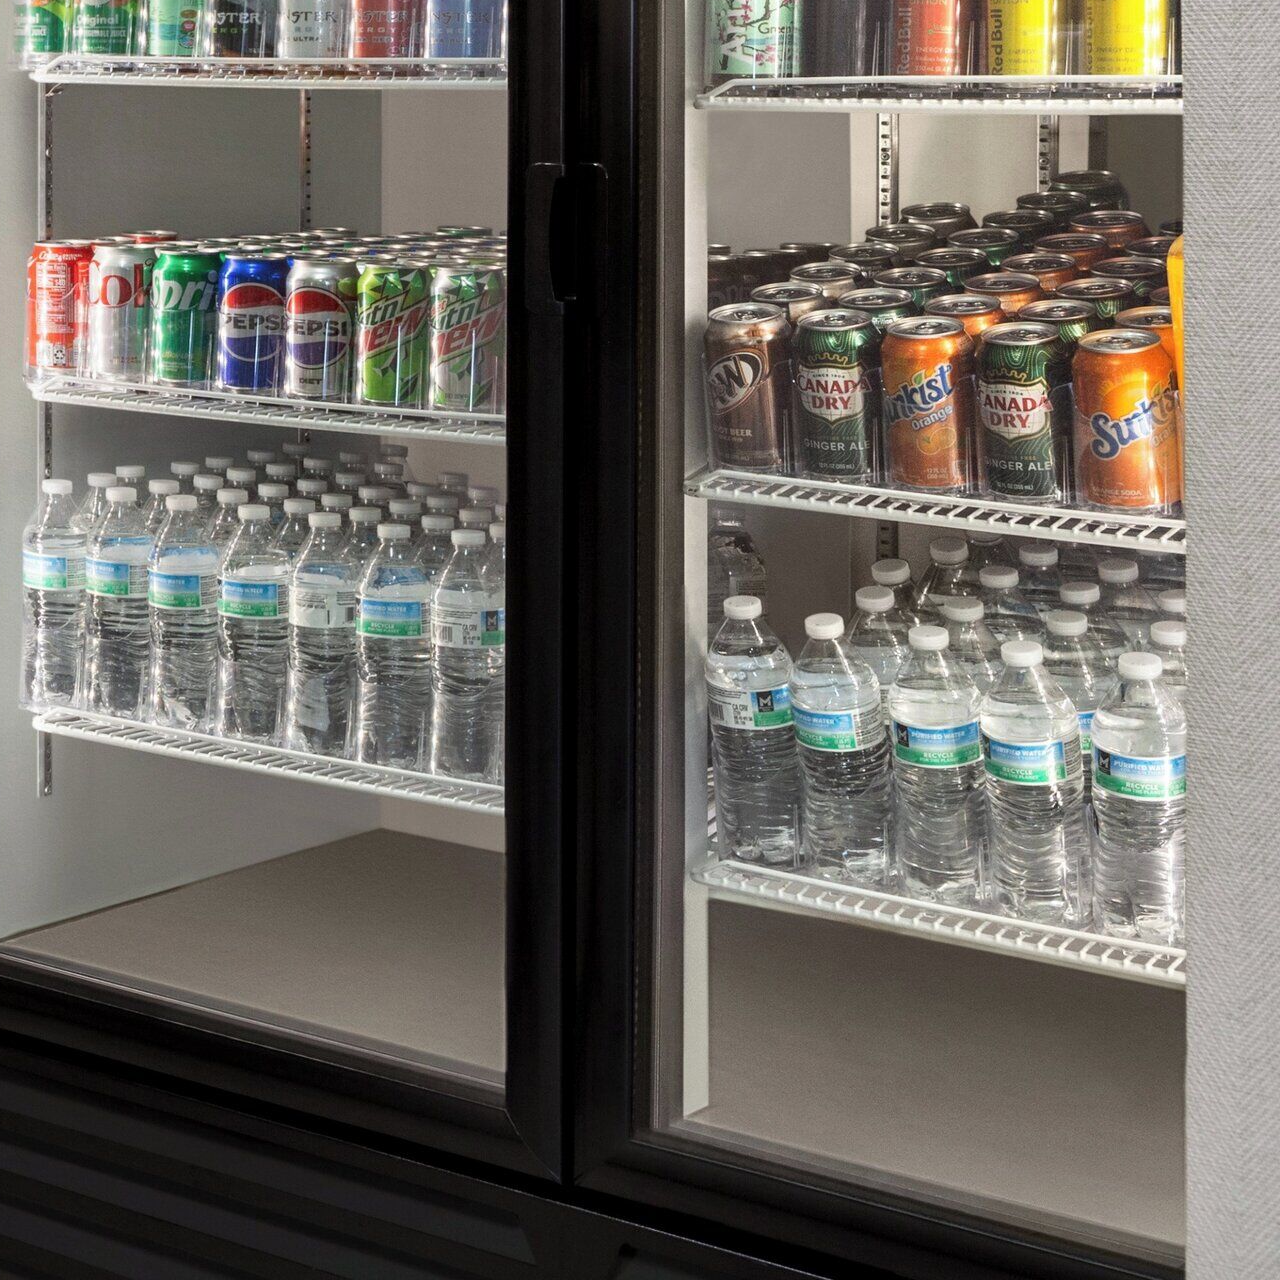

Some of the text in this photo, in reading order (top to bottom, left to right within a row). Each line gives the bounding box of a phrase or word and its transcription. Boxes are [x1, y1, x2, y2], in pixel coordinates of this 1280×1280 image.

[796, 374, 872, 395] CANADA
[812, 396, 851, 410] DRY
[912, 406, 953, 431] Orange
[991, 415, 1028, 429] DRY
[803, 438, 871, 451] GINGER ALE
[1028, 461, 1052, 471] ALE
[923, 752, 954, 760] RECYCLE
[1002, 766, 1033, 775] RECYCLE
[1126, 782, 1159, 790] RECYCLE
